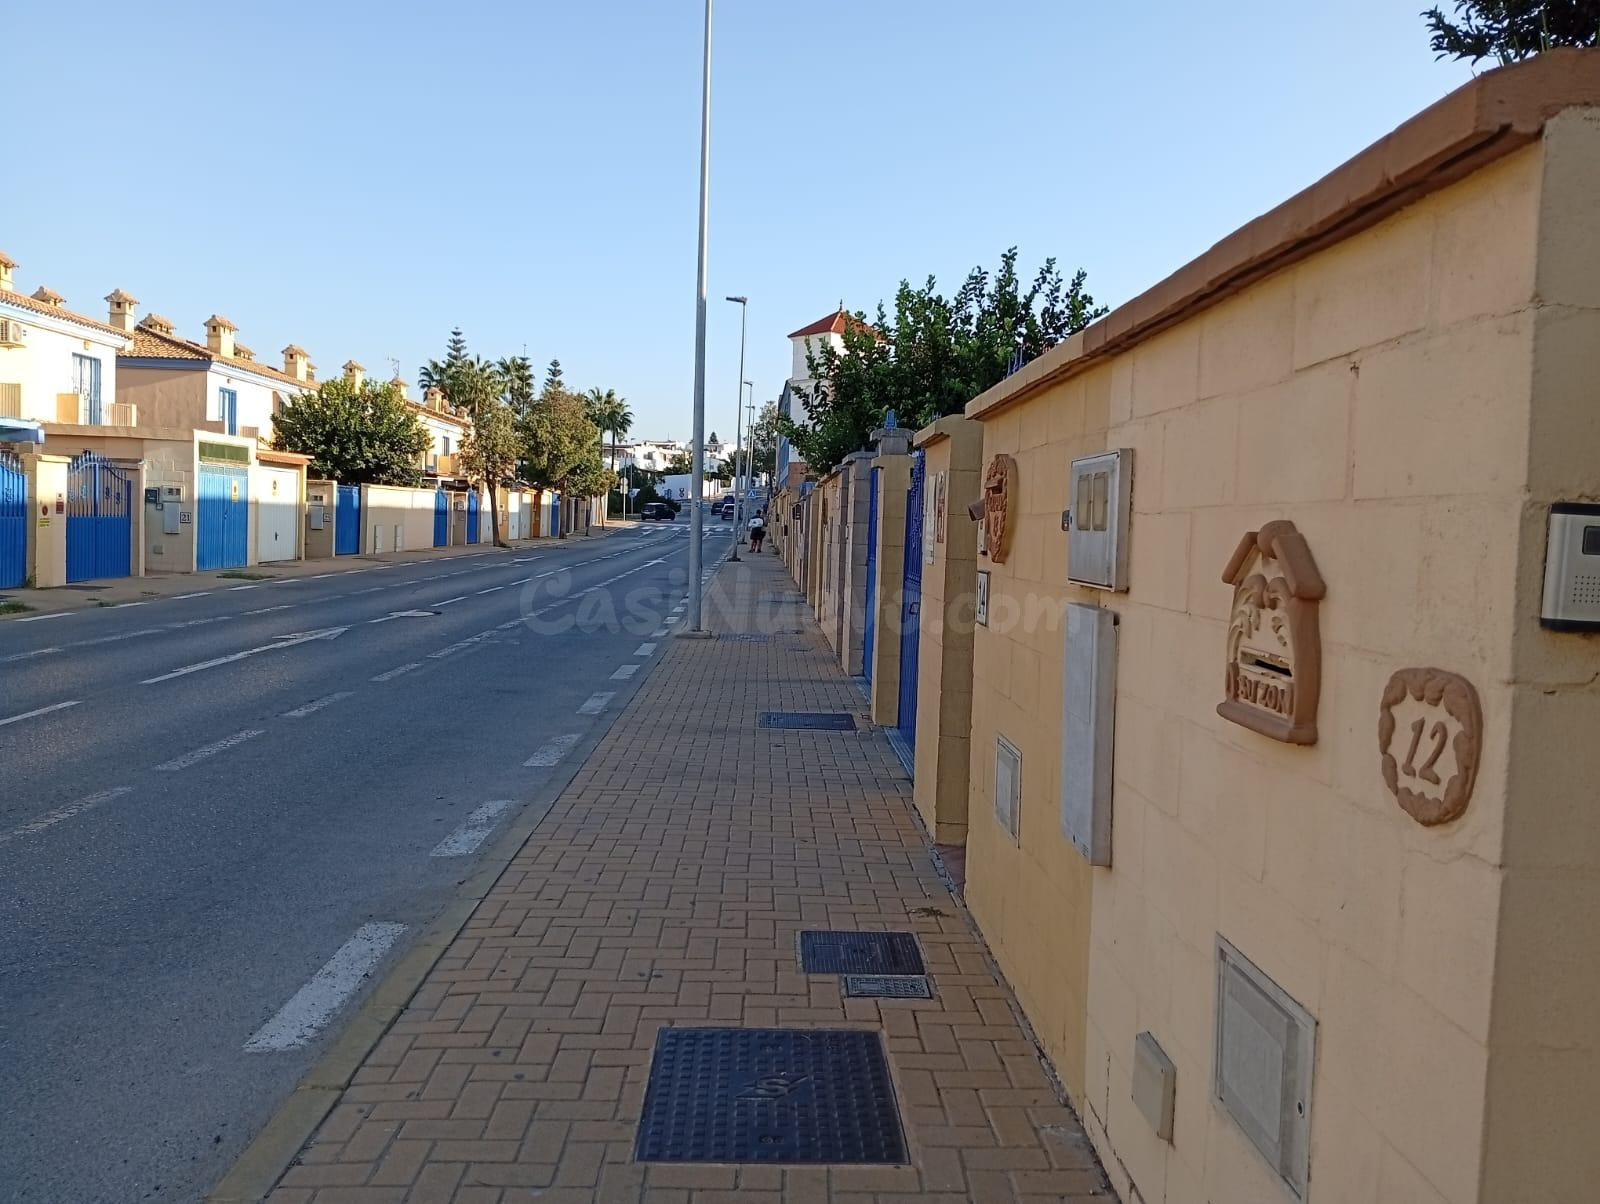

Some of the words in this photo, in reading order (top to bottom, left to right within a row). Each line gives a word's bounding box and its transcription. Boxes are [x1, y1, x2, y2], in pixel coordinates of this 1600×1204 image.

[181, 513, 190, 521] 21
[1239, 675, 1295, 716] BUZON
[1401, 716, 1449, 785] 12
